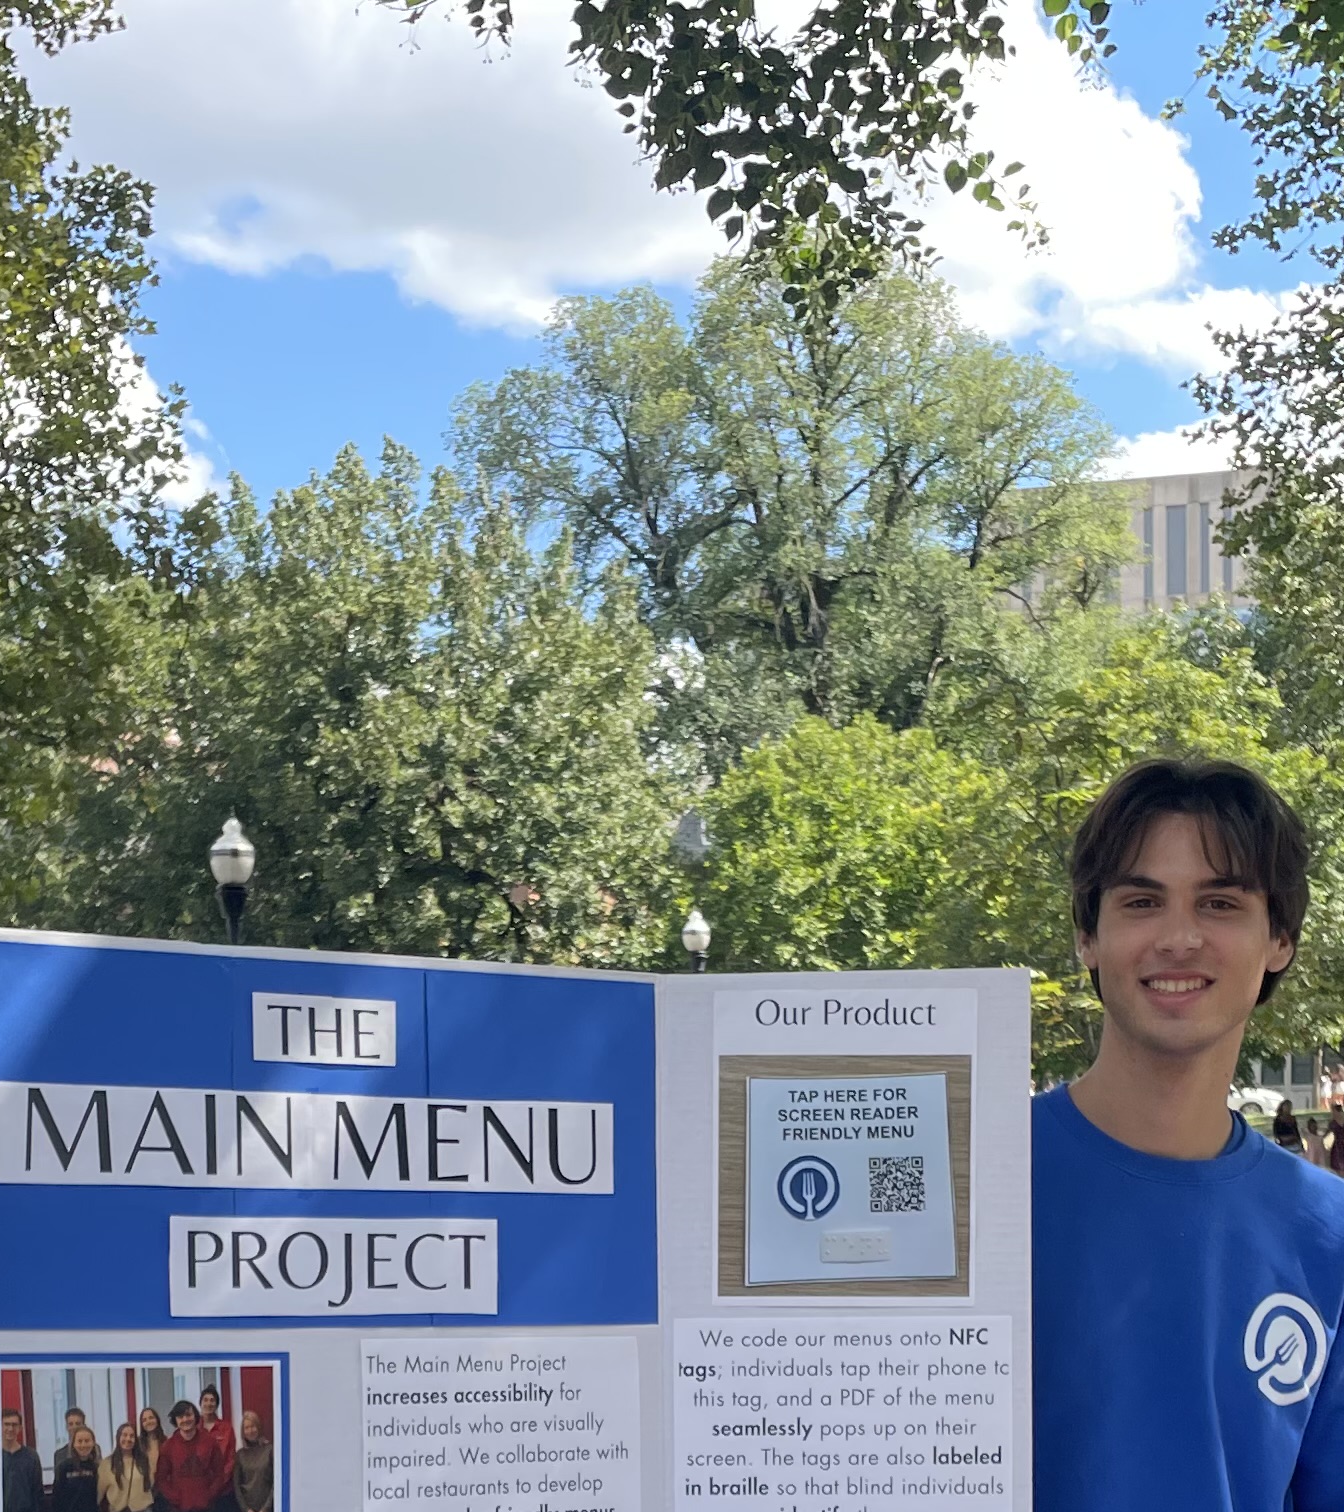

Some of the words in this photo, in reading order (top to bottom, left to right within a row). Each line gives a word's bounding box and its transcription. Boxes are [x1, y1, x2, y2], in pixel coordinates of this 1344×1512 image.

[755, 998, 811, 1026] Our
[823, 998, 937, 1026] Product
[267, 1004, 381, 1060] THE
[788, 1090, 819, 1104] TAP
[823, 1088, 869, 1103] HERE
[873, 1087, 908, 1102] FOR
[777, 1108, 846, 1123] SCREEN
[850, 1106, 919, 1121] READER
[25, 1086, 294, 1179] MAIN
[332, 1100, 598, 1186] MENU
[782, 1126, 863, 1142] FRIENDLY
[867, 1125, 915, 1140] MENU
[186, 1230, 486, 1308] PROJECT
[699, 1329, 734, 1348] We
[741, 1328, 788, 1348] code
[795, 1332, 826, 1347] our
[833, 1331, 893, 1347] menus
[900, 1329, 942, 1347] onto
[949, 1327, 989, 1346] NFC
[366, 1355, 397, 1374] The
[404, 1355, 449, 1374] Main
[456, 1355, 503, 1373] Menu
[510, 1353, 566, 1376] Project
[731, 1358, 834, 1378] individuals
[840, 1359, 871, 1381] tap
[878, 1356, 920, 1377] their
[927, 1356, 987, 1381] phone
[366, 1387, 448, 1406] increases
[454, 1382, 554, 1407] accessibility
[559, 1381, 582, 1402] for
[693, 1388, 725, 1408] this
[732, 1389, 769, 1413] tag,
[776, 1387, 813, 1407] and
[820, 1392, 832, 1407] a
[840, 1388, 877, 1407] PDF
[883, 1386, 904, 1406] of
[909, 1386, 937, 1406] the
[945, 1390, 995, 1406] menu
[367, 1416, 462, 1437] individuals
[468, 1414, 504, 1434] who
[510, 1418, 538, 1433] are
[544, 1411, 604, 1436] visually
[367, 1447, 451, 1473] impaired.
[459, 1447, 490, 1465] We
[496, 1443, 590, 1465] collaborate
[596, 1441, 629, 1460] with
[367, 1479, 410, 1500] local
[417, 1478, 510, 1498] restaurants
[516, 1477, 532, 1494] to
[538, 1471, 603, 1496] develop
